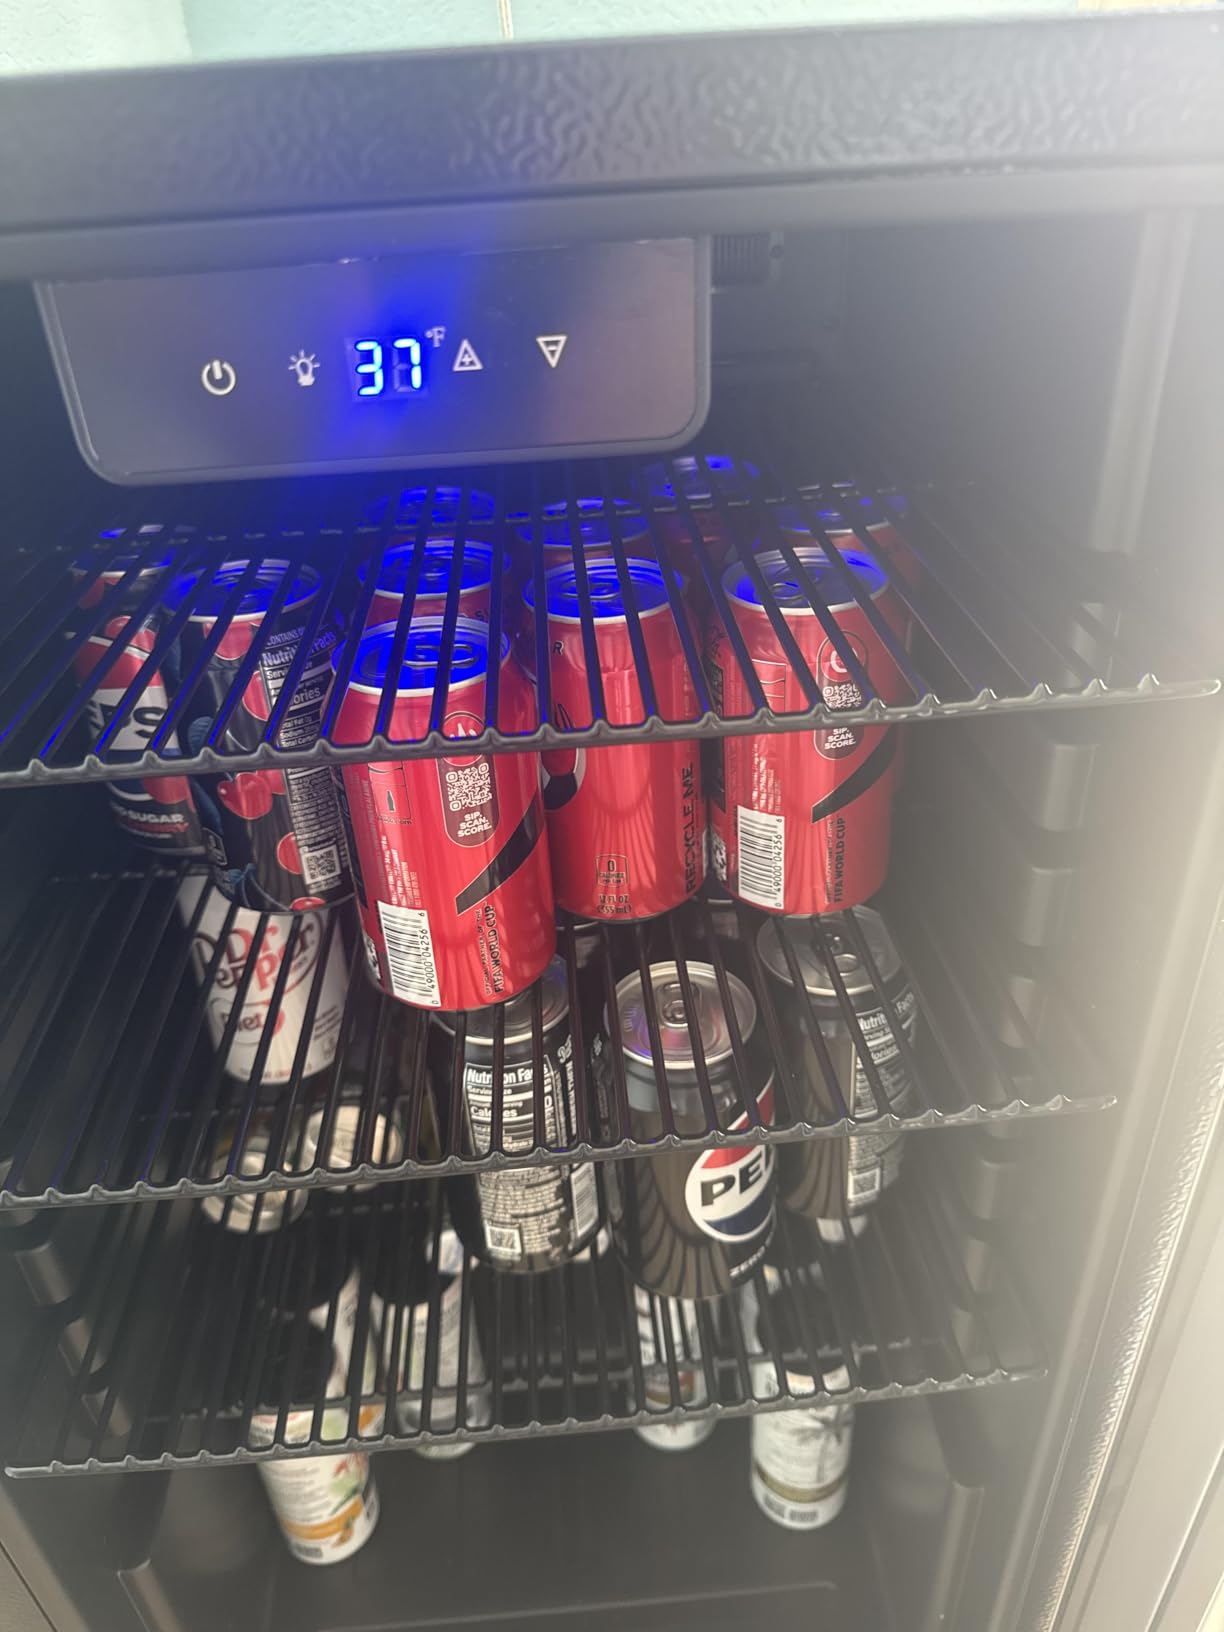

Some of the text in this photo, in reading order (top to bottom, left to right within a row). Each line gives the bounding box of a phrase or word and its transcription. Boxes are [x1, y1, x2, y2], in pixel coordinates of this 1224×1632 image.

[355, 339, 422, 396] 37
[457, 821, 492, 838] SCORE.
[459, 816, 489, 830] SCAN.
[464, 811, 483, 822] SIP.
[773, 834, 782, 862] 04256
[773, 865, 782, 893] 49000
[484, 905, 497, 928] CUP
[418, 929, 431, 958] 04256
[487, 928, 501, 967] WORLD
[425, 962, 435, 989] 49000
[467, 1085, 492, 1095] Servin
